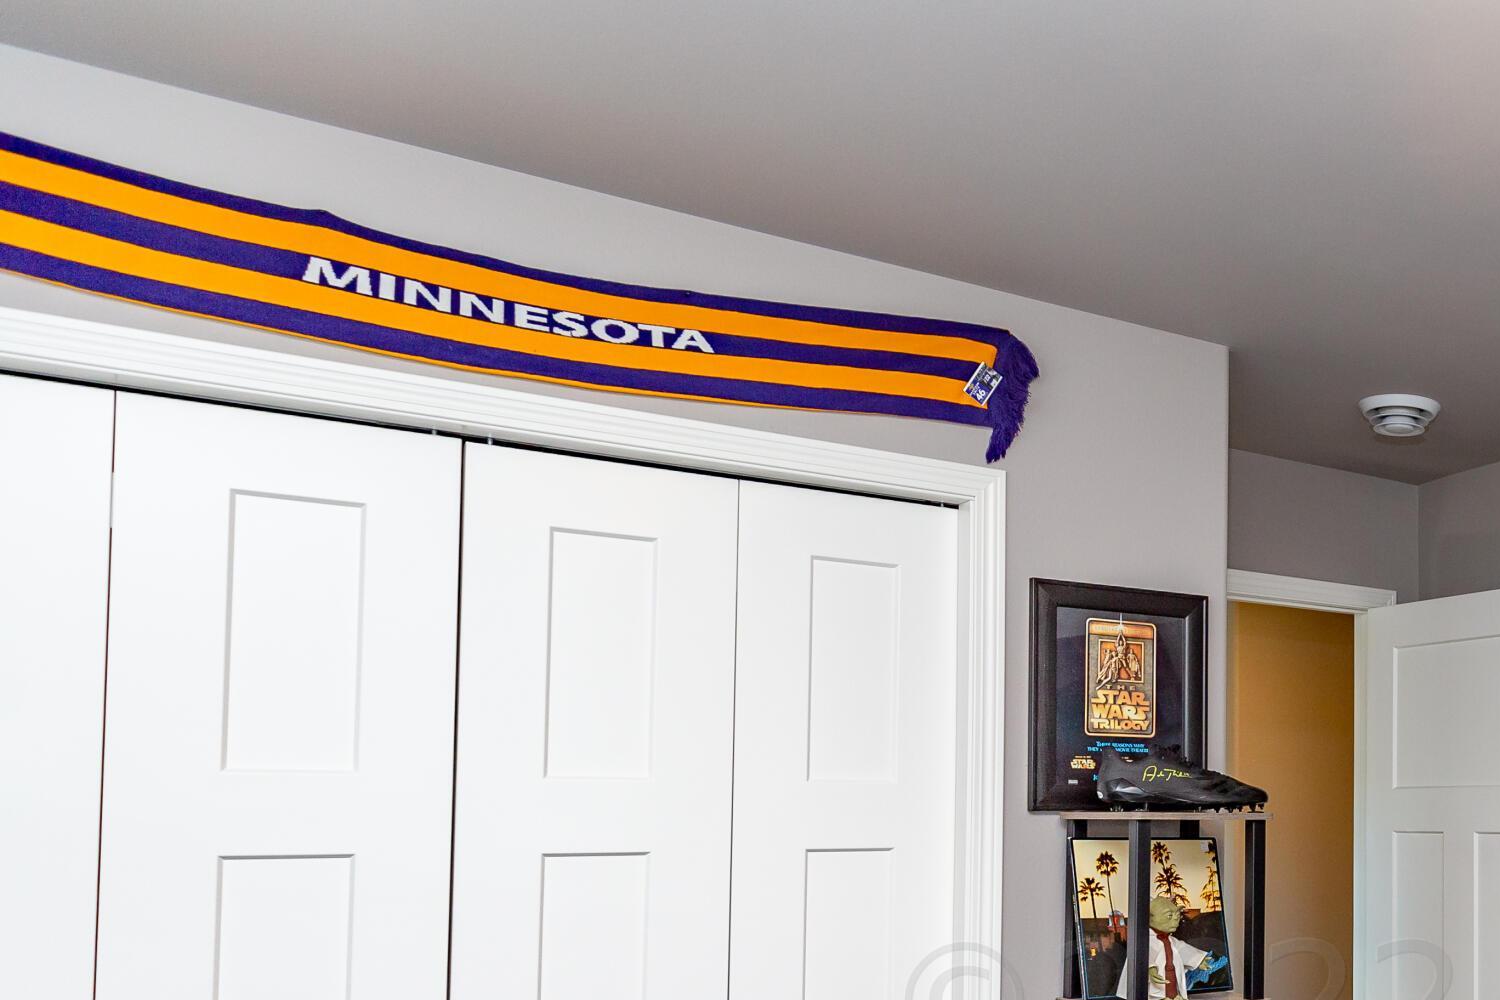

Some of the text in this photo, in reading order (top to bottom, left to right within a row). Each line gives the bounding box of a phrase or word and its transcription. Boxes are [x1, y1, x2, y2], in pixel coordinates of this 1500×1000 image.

[302, 256, 716, 354] MINNESOTA
[1091, 690, 1150, 706] STAR
[1091, 704, 1150, 720] WARS
[1091, 718, 1150, 731] TRILOGY
